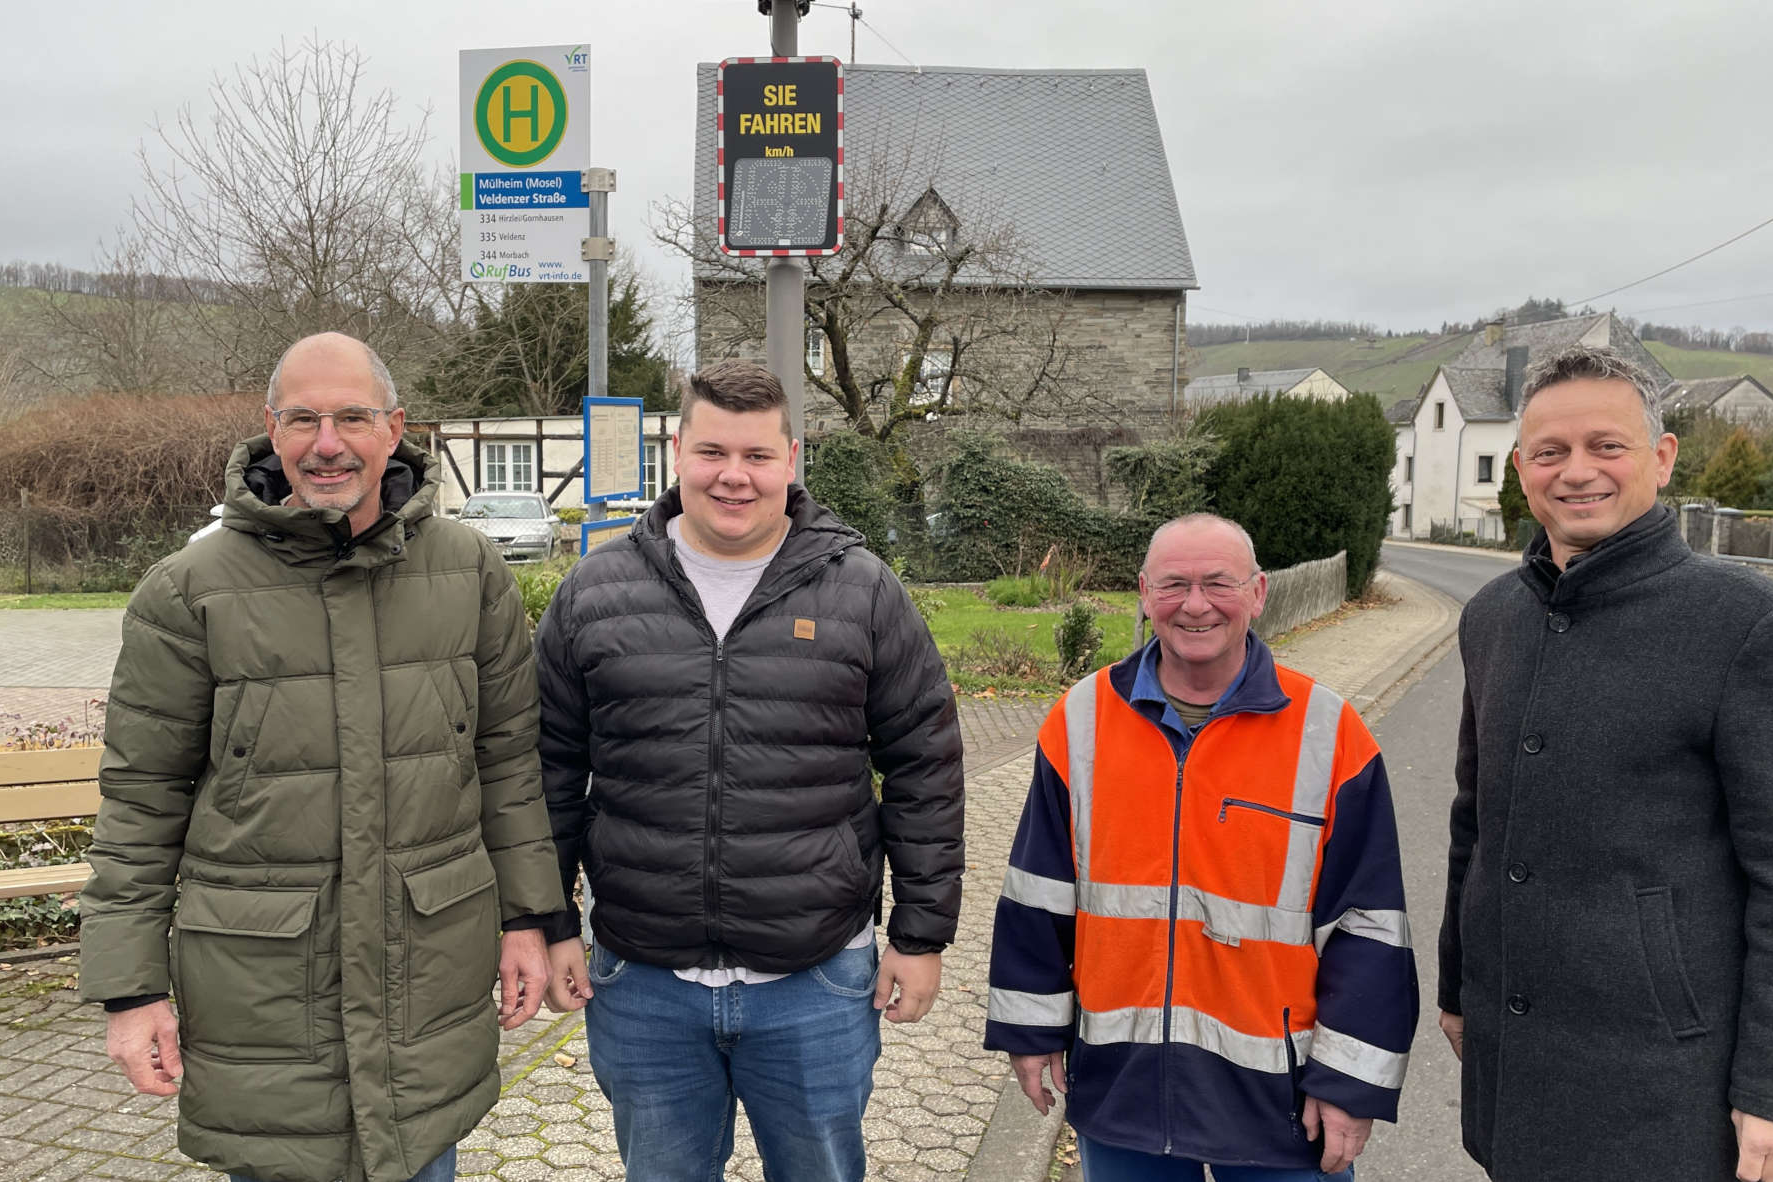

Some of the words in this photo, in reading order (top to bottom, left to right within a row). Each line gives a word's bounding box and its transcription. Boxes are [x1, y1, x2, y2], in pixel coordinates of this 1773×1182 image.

[763, 84, 798, 107] SIE
[502, 84, 539, 143] H
[739, 112, 821, 135] FAHREN
[765, 145, 795, 158] km/h
[479, 178, 523, 190] Mülheim
[525, 176, 563, 190] (Mosel)
[479, 193, 530, 205] Veldenzer
[532, 192, 567, 204] Straße
[480, 213, 497, 224] 334
[480, 232, 497, 242] 335
[499, 233, 527, 241] Veldenz
[480, 250, 497, 260] 344
[499, 251, 530, 259] Morbach
[486, 264, 532, 281] RufBus
